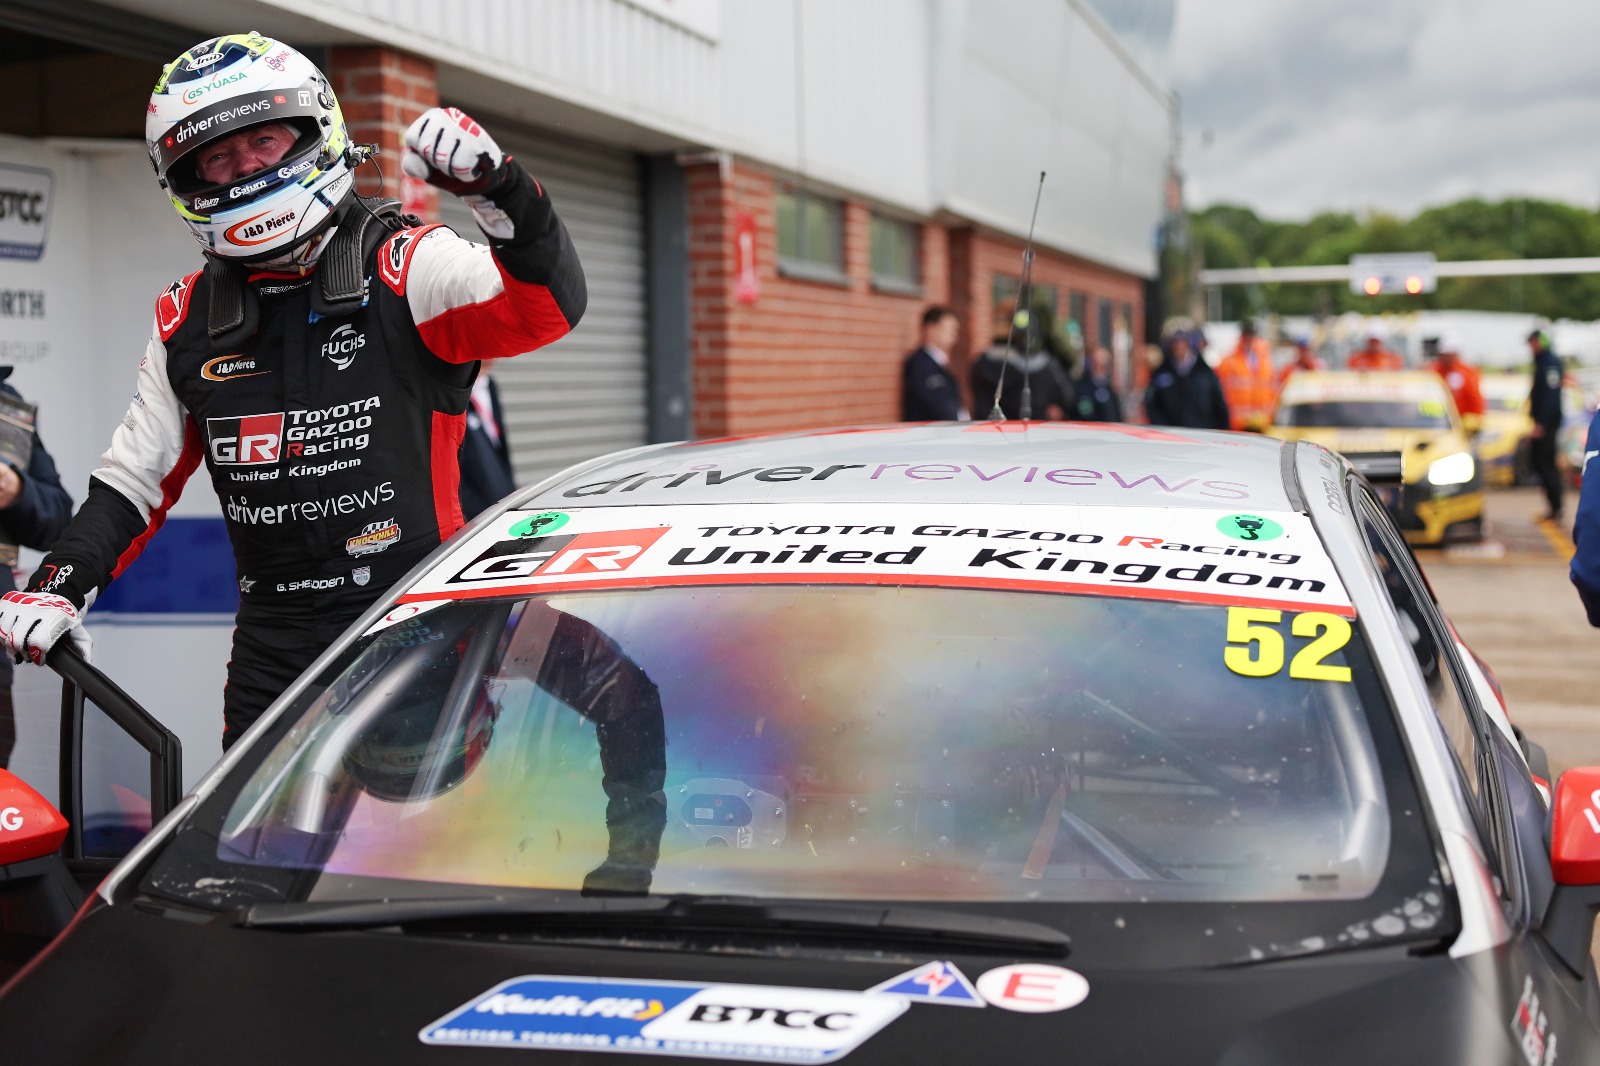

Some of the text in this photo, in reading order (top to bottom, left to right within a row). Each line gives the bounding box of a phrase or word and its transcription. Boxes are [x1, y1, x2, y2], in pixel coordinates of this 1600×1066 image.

[188, 72, 248, 99] GS YUASA
[278, 160, 312, 179] Saturn
[229, 180, 268, 199] Saturn
[195, 197, 220, 211] Saturn
[243, 224, 265, 239] J&D
[265, 211, 296, 231] Pierce
[0, 290, 46, 319] RTH
[321, 332, 367, 358] FUCHS
[233, 360, 256, 371] Pierce
[288, 395, 381, 425] TOYOTA
[211, 415, 373, 463] GR GAZOO
[286, 432, 371, 459] Racing
[229, 456, 362, 482] United Kingdom
[349, 527, 396, 547] KNOCKHILL
[458, 523, 1303, 580] GR TOYOTA GAZOO Racing
[667, 543, 1327, 594] United Kingdom
[276, 583, 287, 592] G.
[1223, 606, 1353, 683] 52
[1002, 972, 1062, 1004] E
[687, 1003, 858, 1032] BTCC
